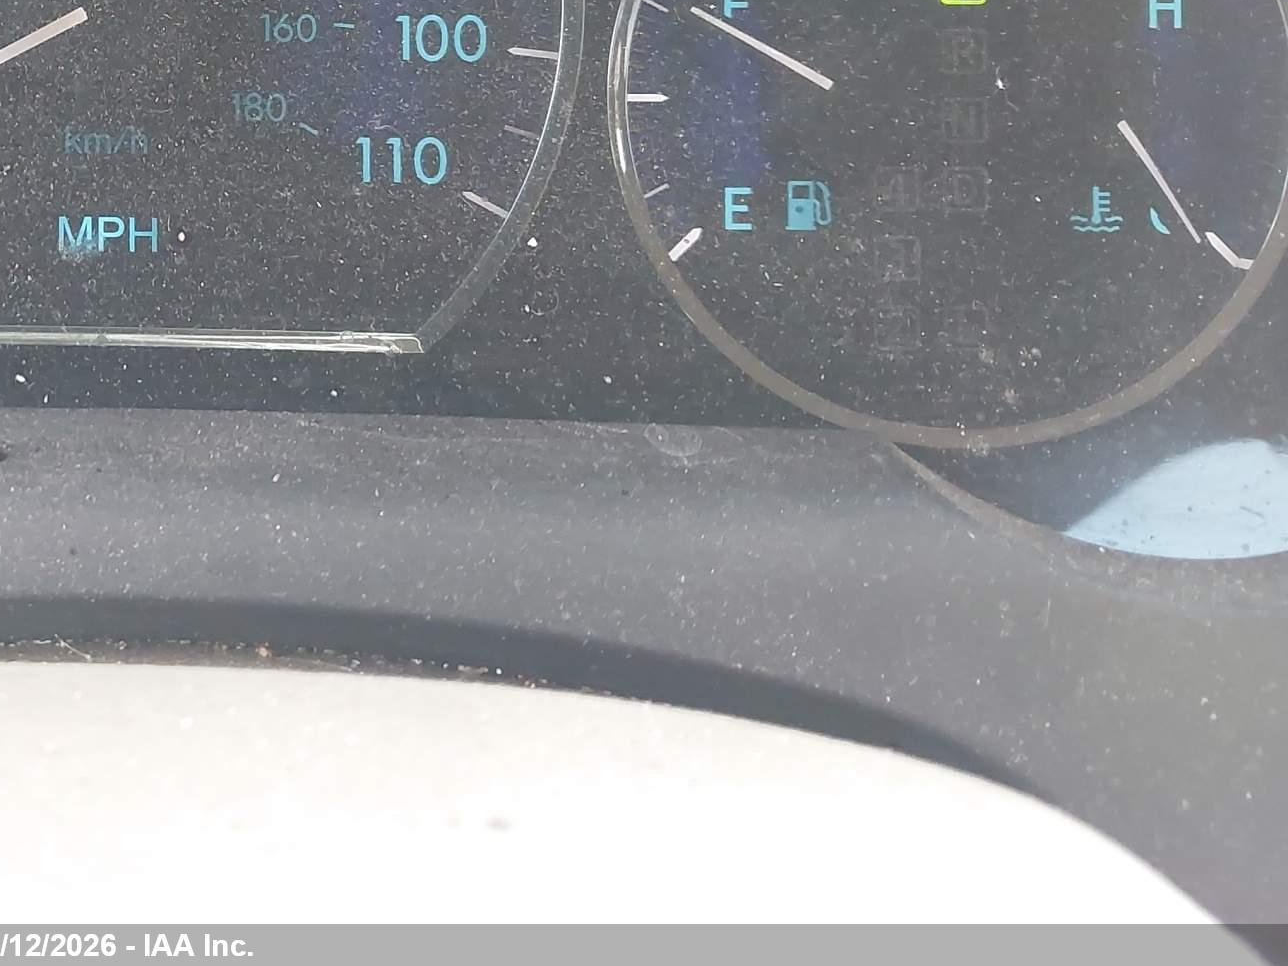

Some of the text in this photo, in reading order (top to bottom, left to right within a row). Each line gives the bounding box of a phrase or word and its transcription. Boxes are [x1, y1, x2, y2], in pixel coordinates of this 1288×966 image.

[262, 13, 317, 43] 160
[396, 14, 487, 63] 100
[233, 93, 287, 123] 180
[65, 125, 148, 155] km/h
[357, 137, 448, 184] 110
[723, 186, 752, 231] E
[58, 216, 158, 252] MPH
